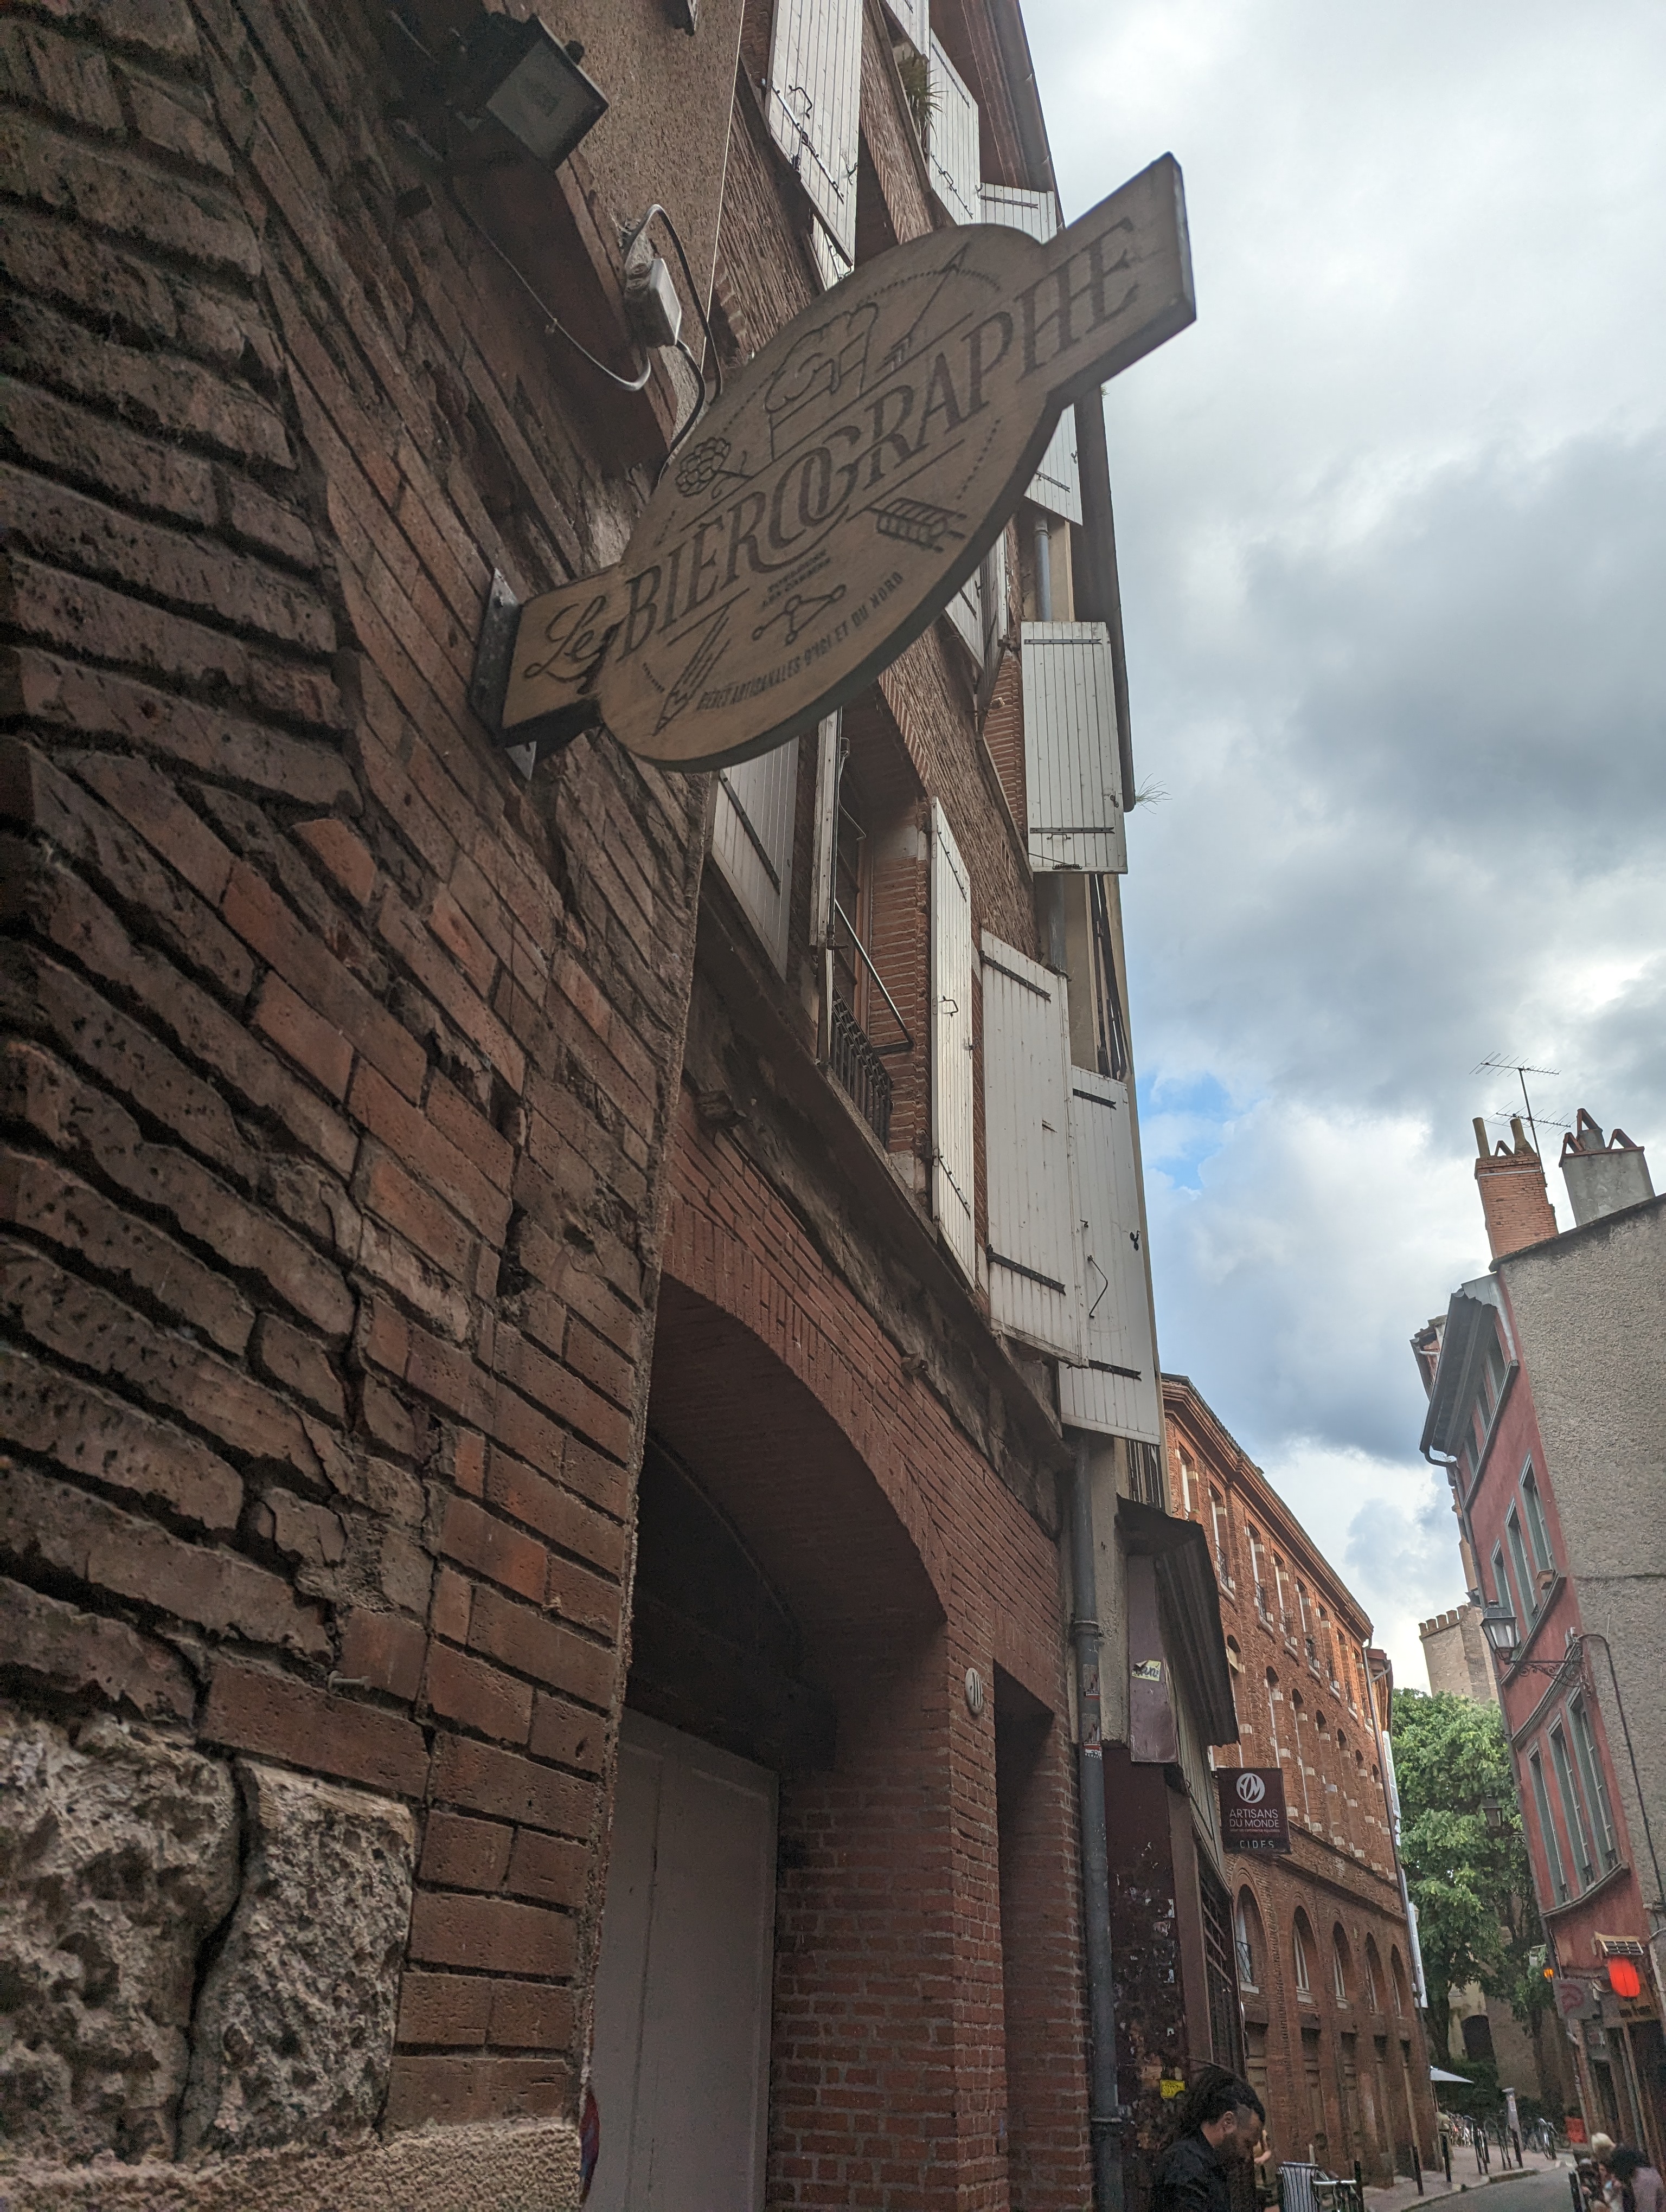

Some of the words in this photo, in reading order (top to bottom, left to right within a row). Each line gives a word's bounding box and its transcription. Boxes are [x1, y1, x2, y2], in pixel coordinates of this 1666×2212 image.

[835, 621, 848, 642] ET
[851, 605, 869, 627] DU
[870, 571, 904, 608] NORD
[523, 596, 626, 695] Le
[1229, 1809, 1278, 1818] ARTISANS
[1229, 1819, 1242, 1827] DU
[1245, 1819, 1279, 1828] MONDE
